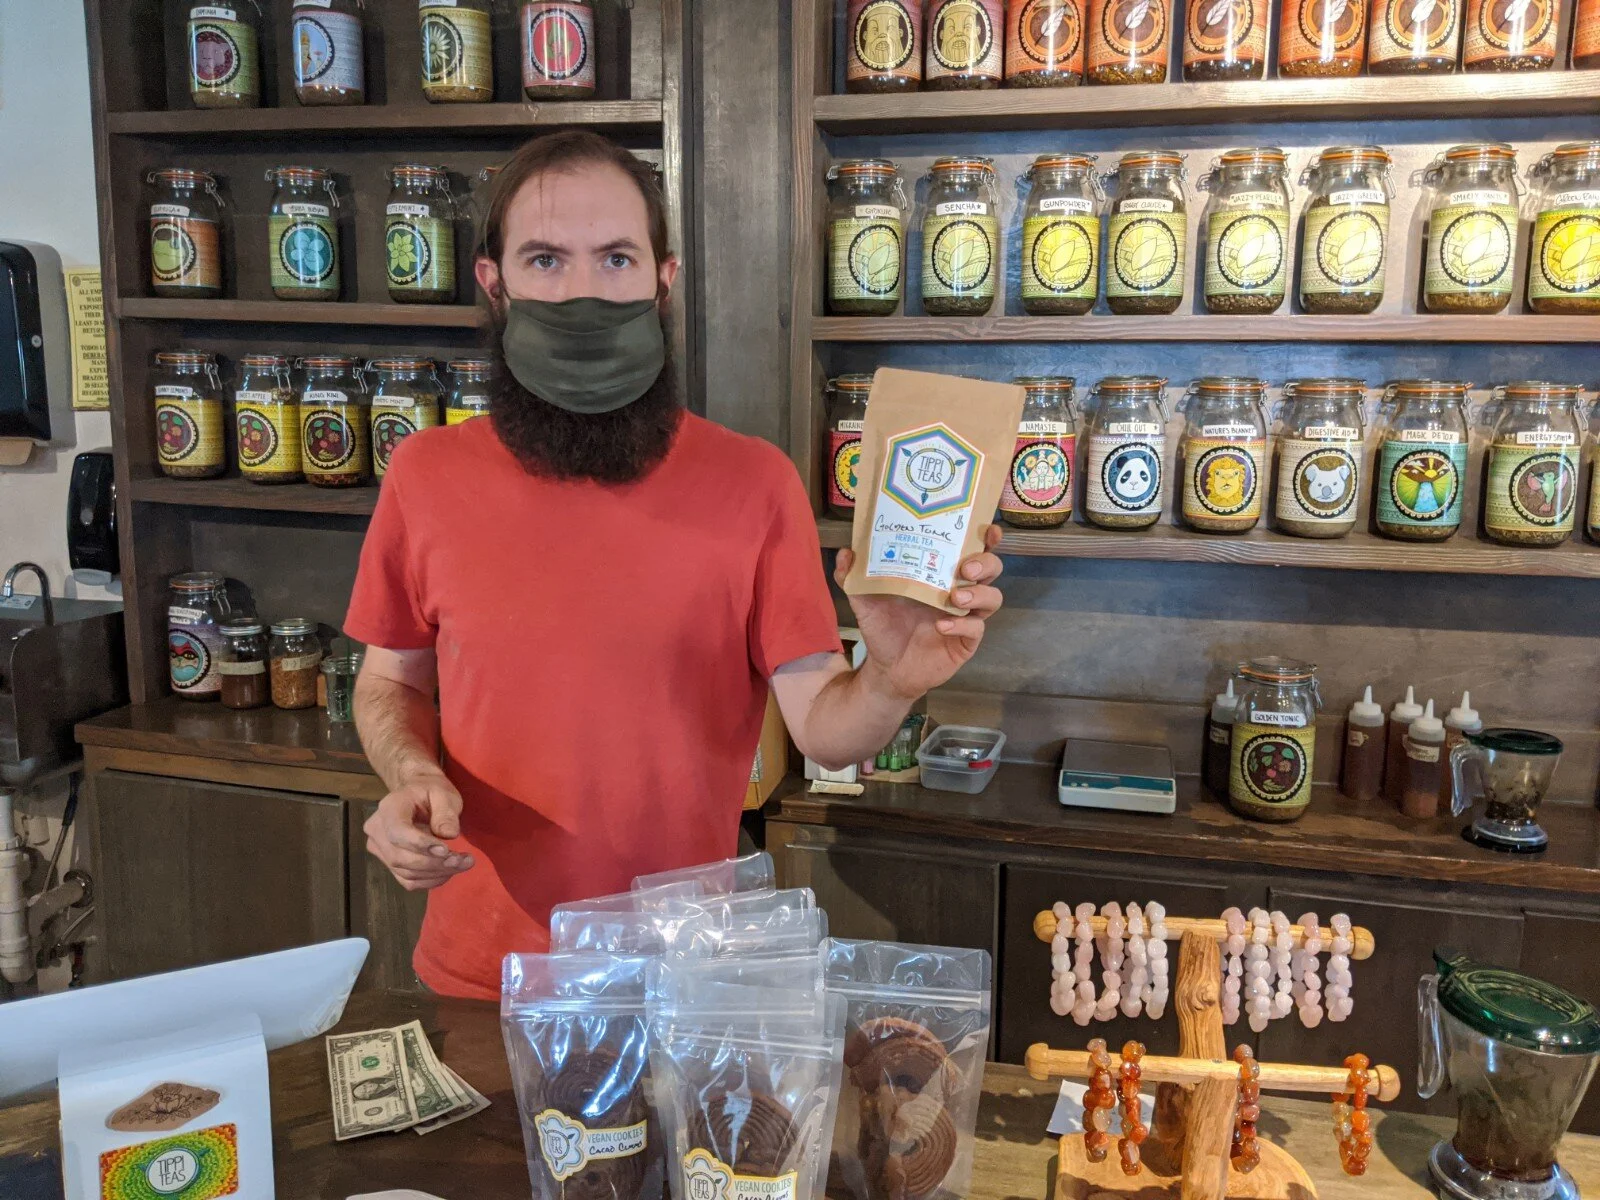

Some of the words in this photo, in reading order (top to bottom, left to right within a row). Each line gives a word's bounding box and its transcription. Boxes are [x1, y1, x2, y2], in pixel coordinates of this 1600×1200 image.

[944, 203, 976, 212] SENCHA
[1044, 200, 1087, 209] GUNPOWDER
[1025, 423, 1057, 432] NAMASTE
[1116, 423, 1132, 432] CHILL
[1135, 423, 1147, 432] OUT
[1308, 428, 1340, 437] DIGESTIVE
[1341, 429, 1351, 437] AID
[1406, 431, 1427, 440] MAGIC
[1524, 433, 1552, 442] ENERGY
[920, 456, 944, 473] TIPPI
[918, 468, 942, 484] TEAS
[895, 534, 919, 544] HERBAL
[921, 538, 933, 547] TEA
[1255, 714, 1278, 722] GOLDEN
[587, 1133, 611, 1144] VEGAN
[612, 1127, 643, 1141] COOKIES
[157, 1155, 185, 1173] TIPPI
[159, 1170, 186, 1186] TEAS
[694, 1179, 709, 1190] TIPPI
[734, 1180, 760, 1193] VEGAN
[761, 1177, 792, 1193] COOKIES
[694, 1188, 710, 1199] TEAS
